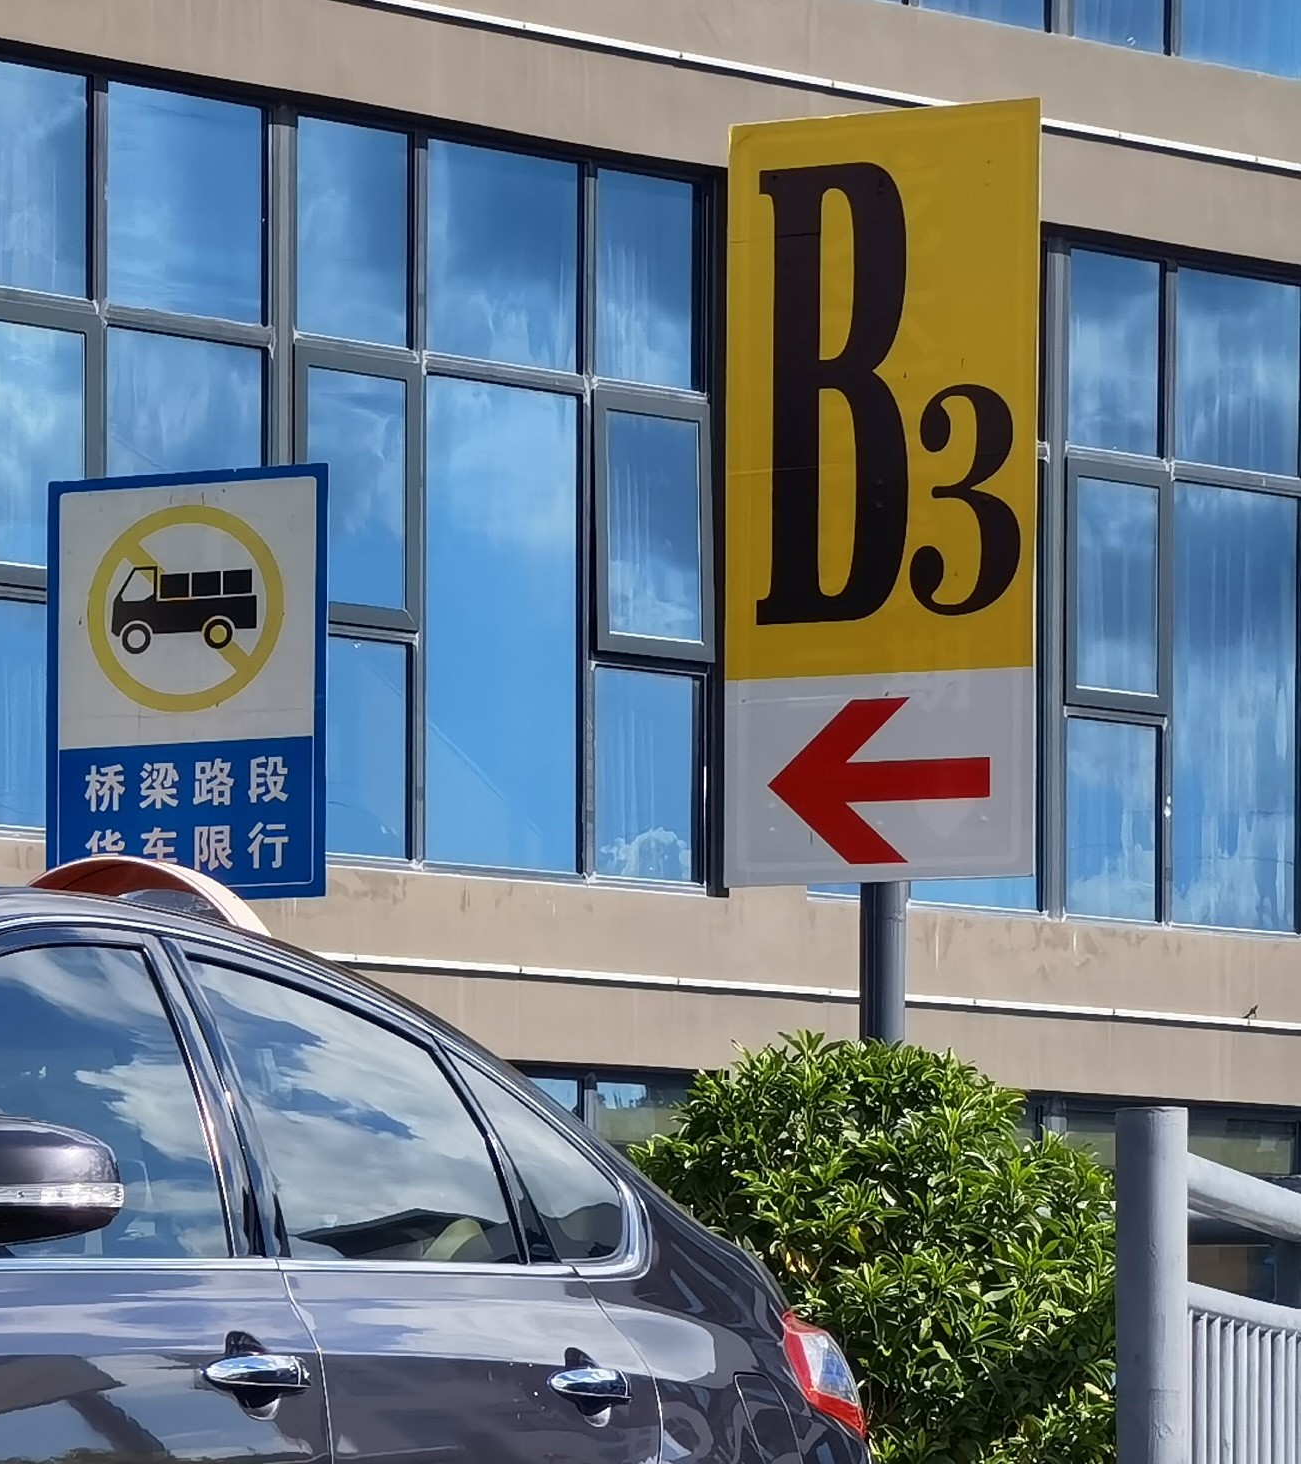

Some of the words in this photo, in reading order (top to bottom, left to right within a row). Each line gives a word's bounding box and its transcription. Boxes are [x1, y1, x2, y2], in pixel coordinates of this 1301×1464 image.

[756, 160, 1021, 626] B3
[84, 755, 289, 813] 桥梁路段
